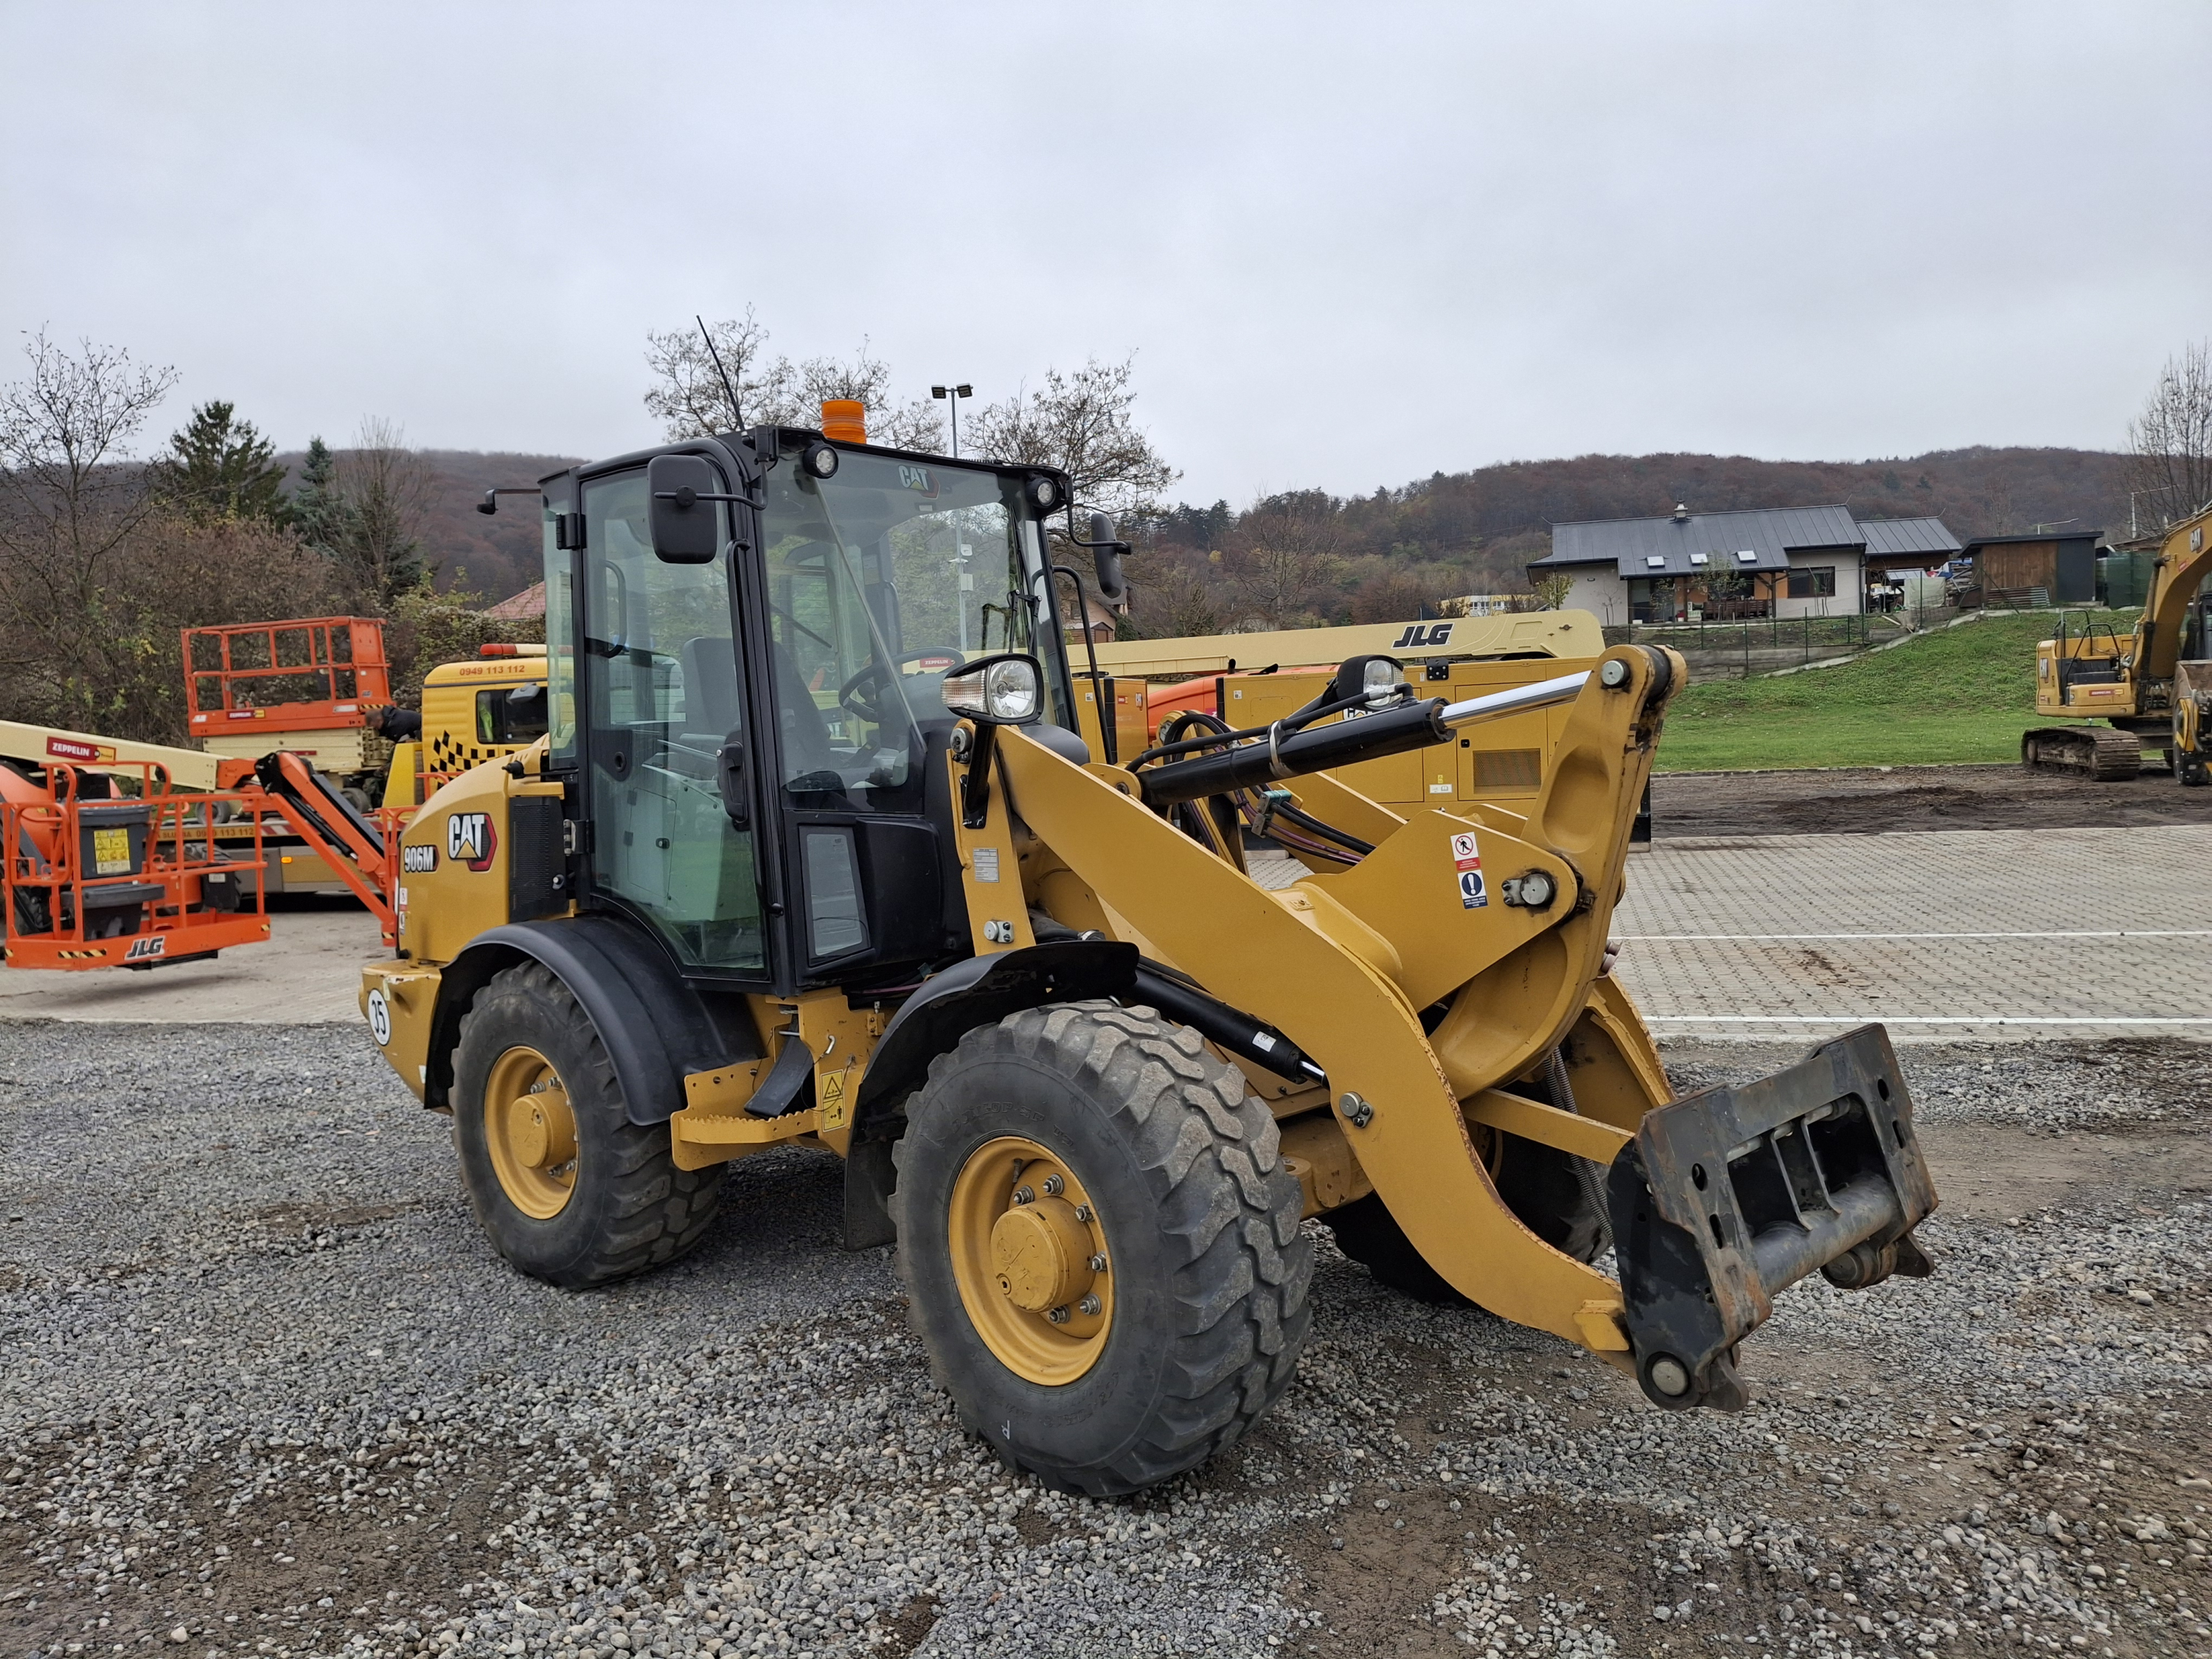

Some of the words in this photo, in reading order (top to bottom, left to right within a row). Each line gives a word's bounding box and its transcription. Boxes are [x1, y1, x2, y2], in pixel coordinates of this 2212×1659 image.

[899, 465, 928, 491] CAT
[1392, 623, 1454, 648] JLG
[459, 667, 483, 676] 0949
[487, 666, 504, 675] 113
[507, 664, 525, 673] 112
[52, 742, 90, 757] ZEPPELIN
[448, 813, 485, 859] CAT
[404, 845, 434, 872] 906M
[125, 936, 164, 959] JLG
[372, 999, 386, 1035] 35
